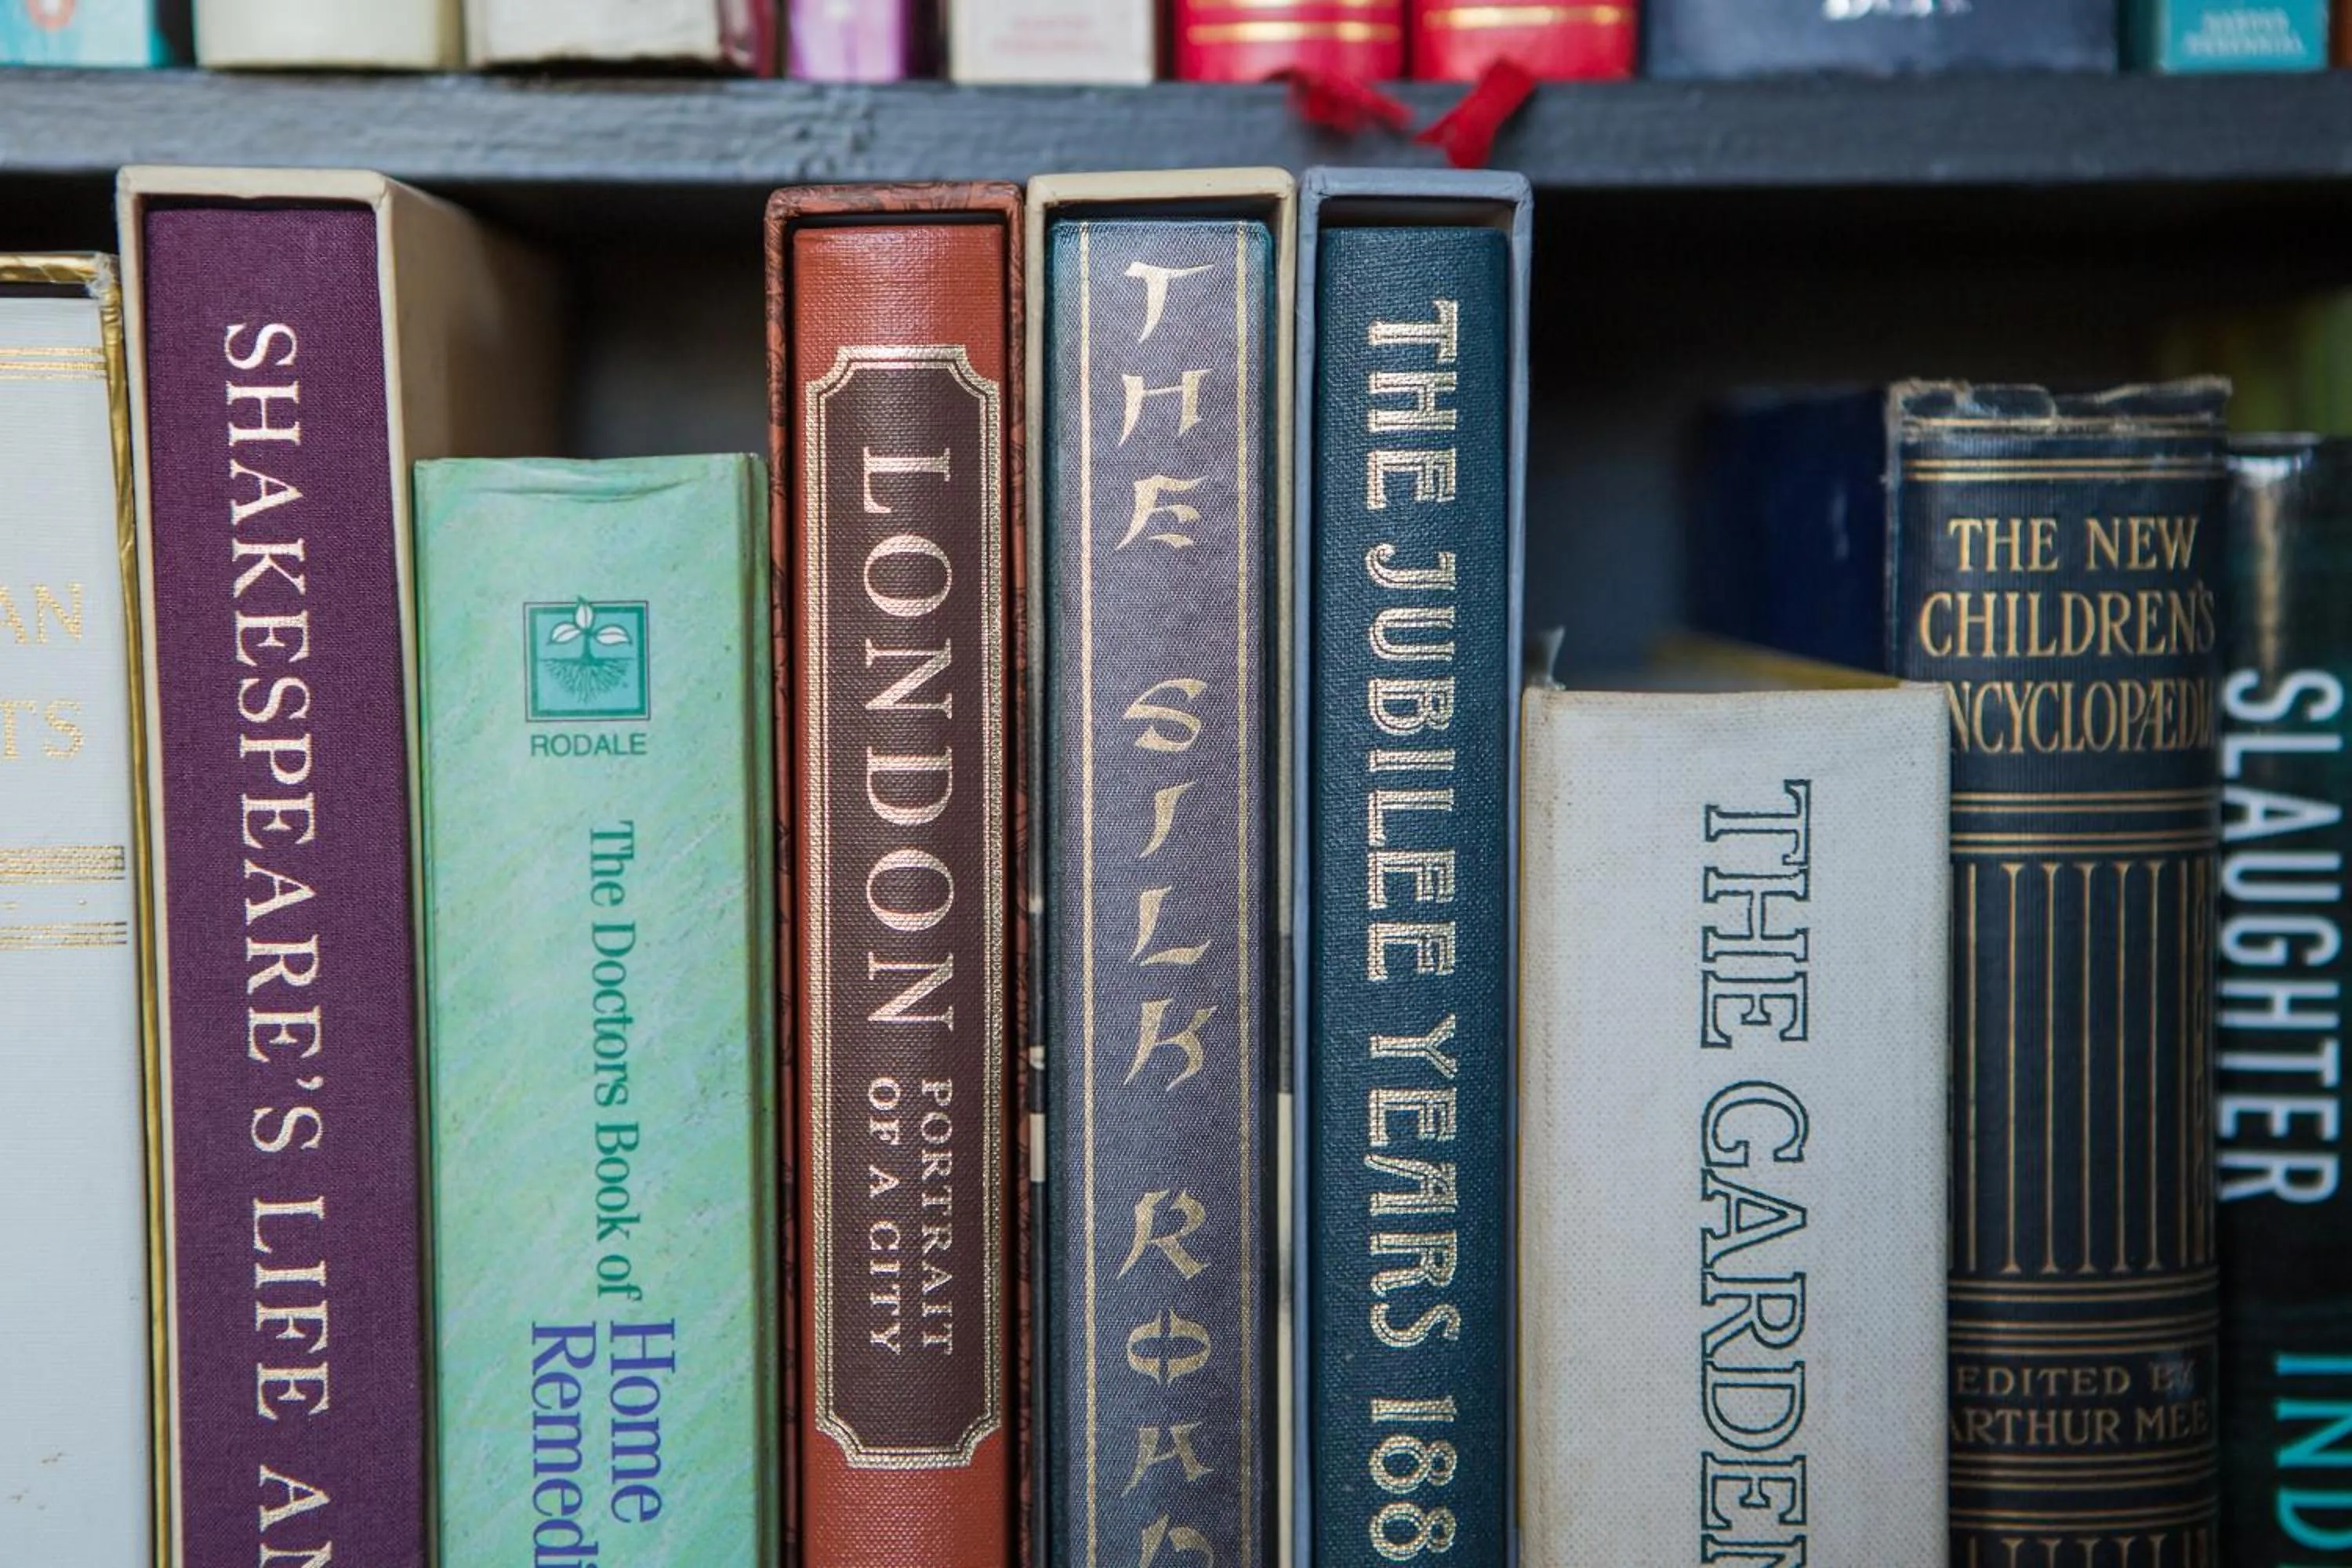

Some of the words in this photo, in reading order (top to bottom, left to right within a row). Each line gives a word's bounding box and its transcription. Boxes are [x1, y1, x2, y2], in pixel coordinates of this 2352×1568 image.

[1116, 260, 1214, 550] THE
[1366, 299, 1458, 511] THE
[1919, 578, 2216, 658] CHILDREN'S
[1948, 515, 2060, 572] THE
[2085, 514, 2199, 572] NEW
[222, 321, 324, 1152] SHAKESPEARE'S
[529, 732, 648, 757] RODALE
[863, 445, 955, 1032] LONDON
[1365, 543, 1457, 982] JUBILEE
[589, 818, 636, 908] The
[1121, 677, 1218, 1091] SILK
[1701, 778, 1811, 1049] THE
[2218, 668, 2343, 1205] SLAUGHTER
[590, 920, 637, 1107] Doctors
[868, 1076, 902, 1146] OF
[594, 1121, 641, 1242] Book
[596, 1254, 643, 1302] of
[869, 1163, 901, 1199] A
[920, 1077, 953, 1356] PORTRAIT
[1363, 1013, 1462, 1349] YEARS
[252, 1195, 330, 1421] LIFE
[869, 1219, 901, 1355] CITY
[1956, 1365, 2131, 1398] EDITED
[608, 1318, 676, 1523] Home
[2134, 1399, 2209, 1444] MEE
[2276, 1353, 2352, 1568] IND
